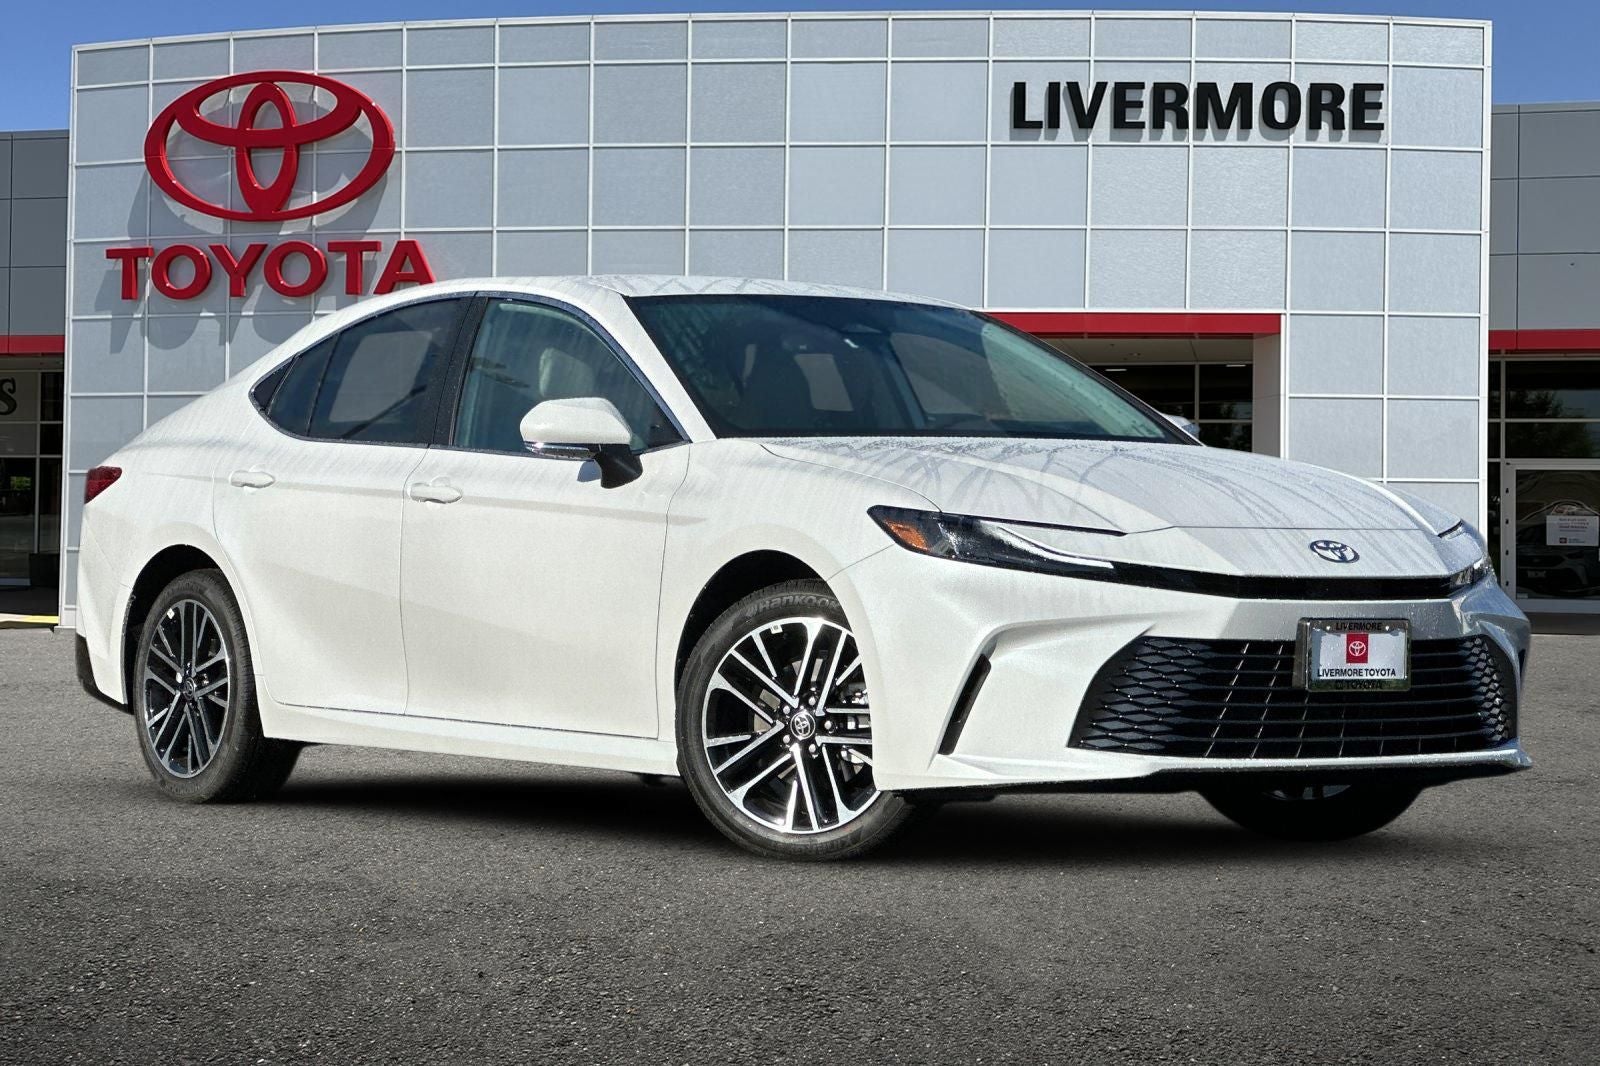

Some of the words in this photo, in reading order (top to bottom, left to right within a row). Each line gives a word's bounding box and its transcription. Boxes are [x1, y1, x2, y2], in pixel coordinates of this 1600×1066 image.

[1012, 81, 1385, 131] LIVERMORE
[106, 240, 436, 300] TOYOTA
[1336, 622, 1382, 631] LIVERMORE
[1317, 668, 1363, 678] LIVERMORE
[1365, 668, 1396, 677] TOYOTA
